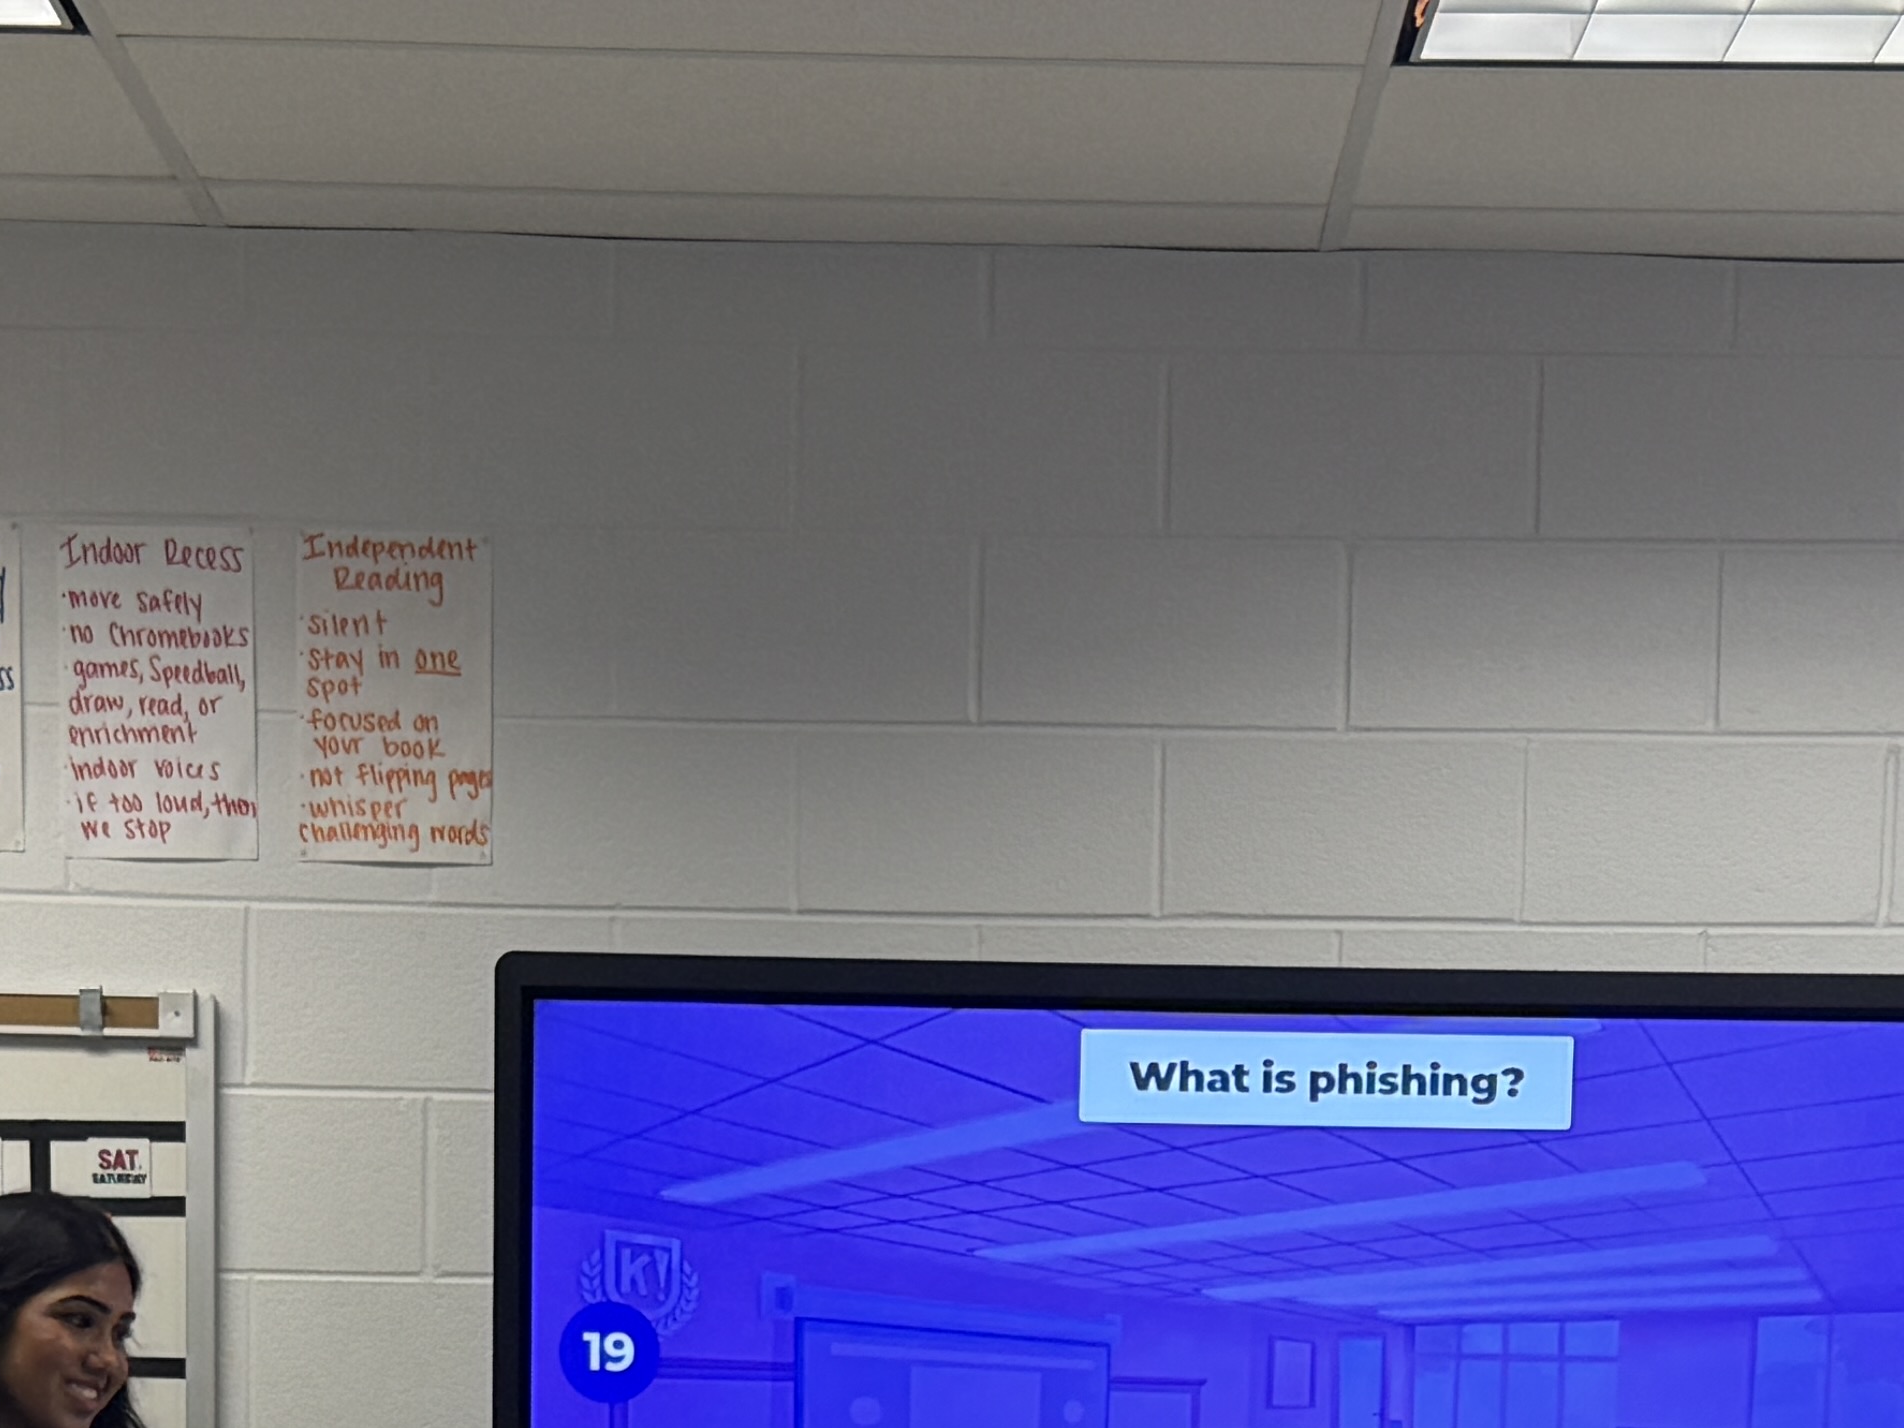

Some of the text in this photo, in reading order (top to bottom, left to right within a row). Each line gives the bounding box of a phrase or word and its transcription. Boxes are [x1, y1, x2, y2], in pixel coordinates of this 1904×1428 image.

[60, 533, 244, 573] Indoor Recess
[303, 533, 478, 564] Independent
[333, 562, 444, 607] Reading
[70, 624, 93, 644] no
[68, 723, 197, 746] enrichment
[307, 709, 438, 733] focused on
[383, 736, 446, 759] book
[309, 796, 407, 819] whisper
[1129, 1058, 1525, 1104] What is phishing?
[582, 1331, 635, 1373] 19
